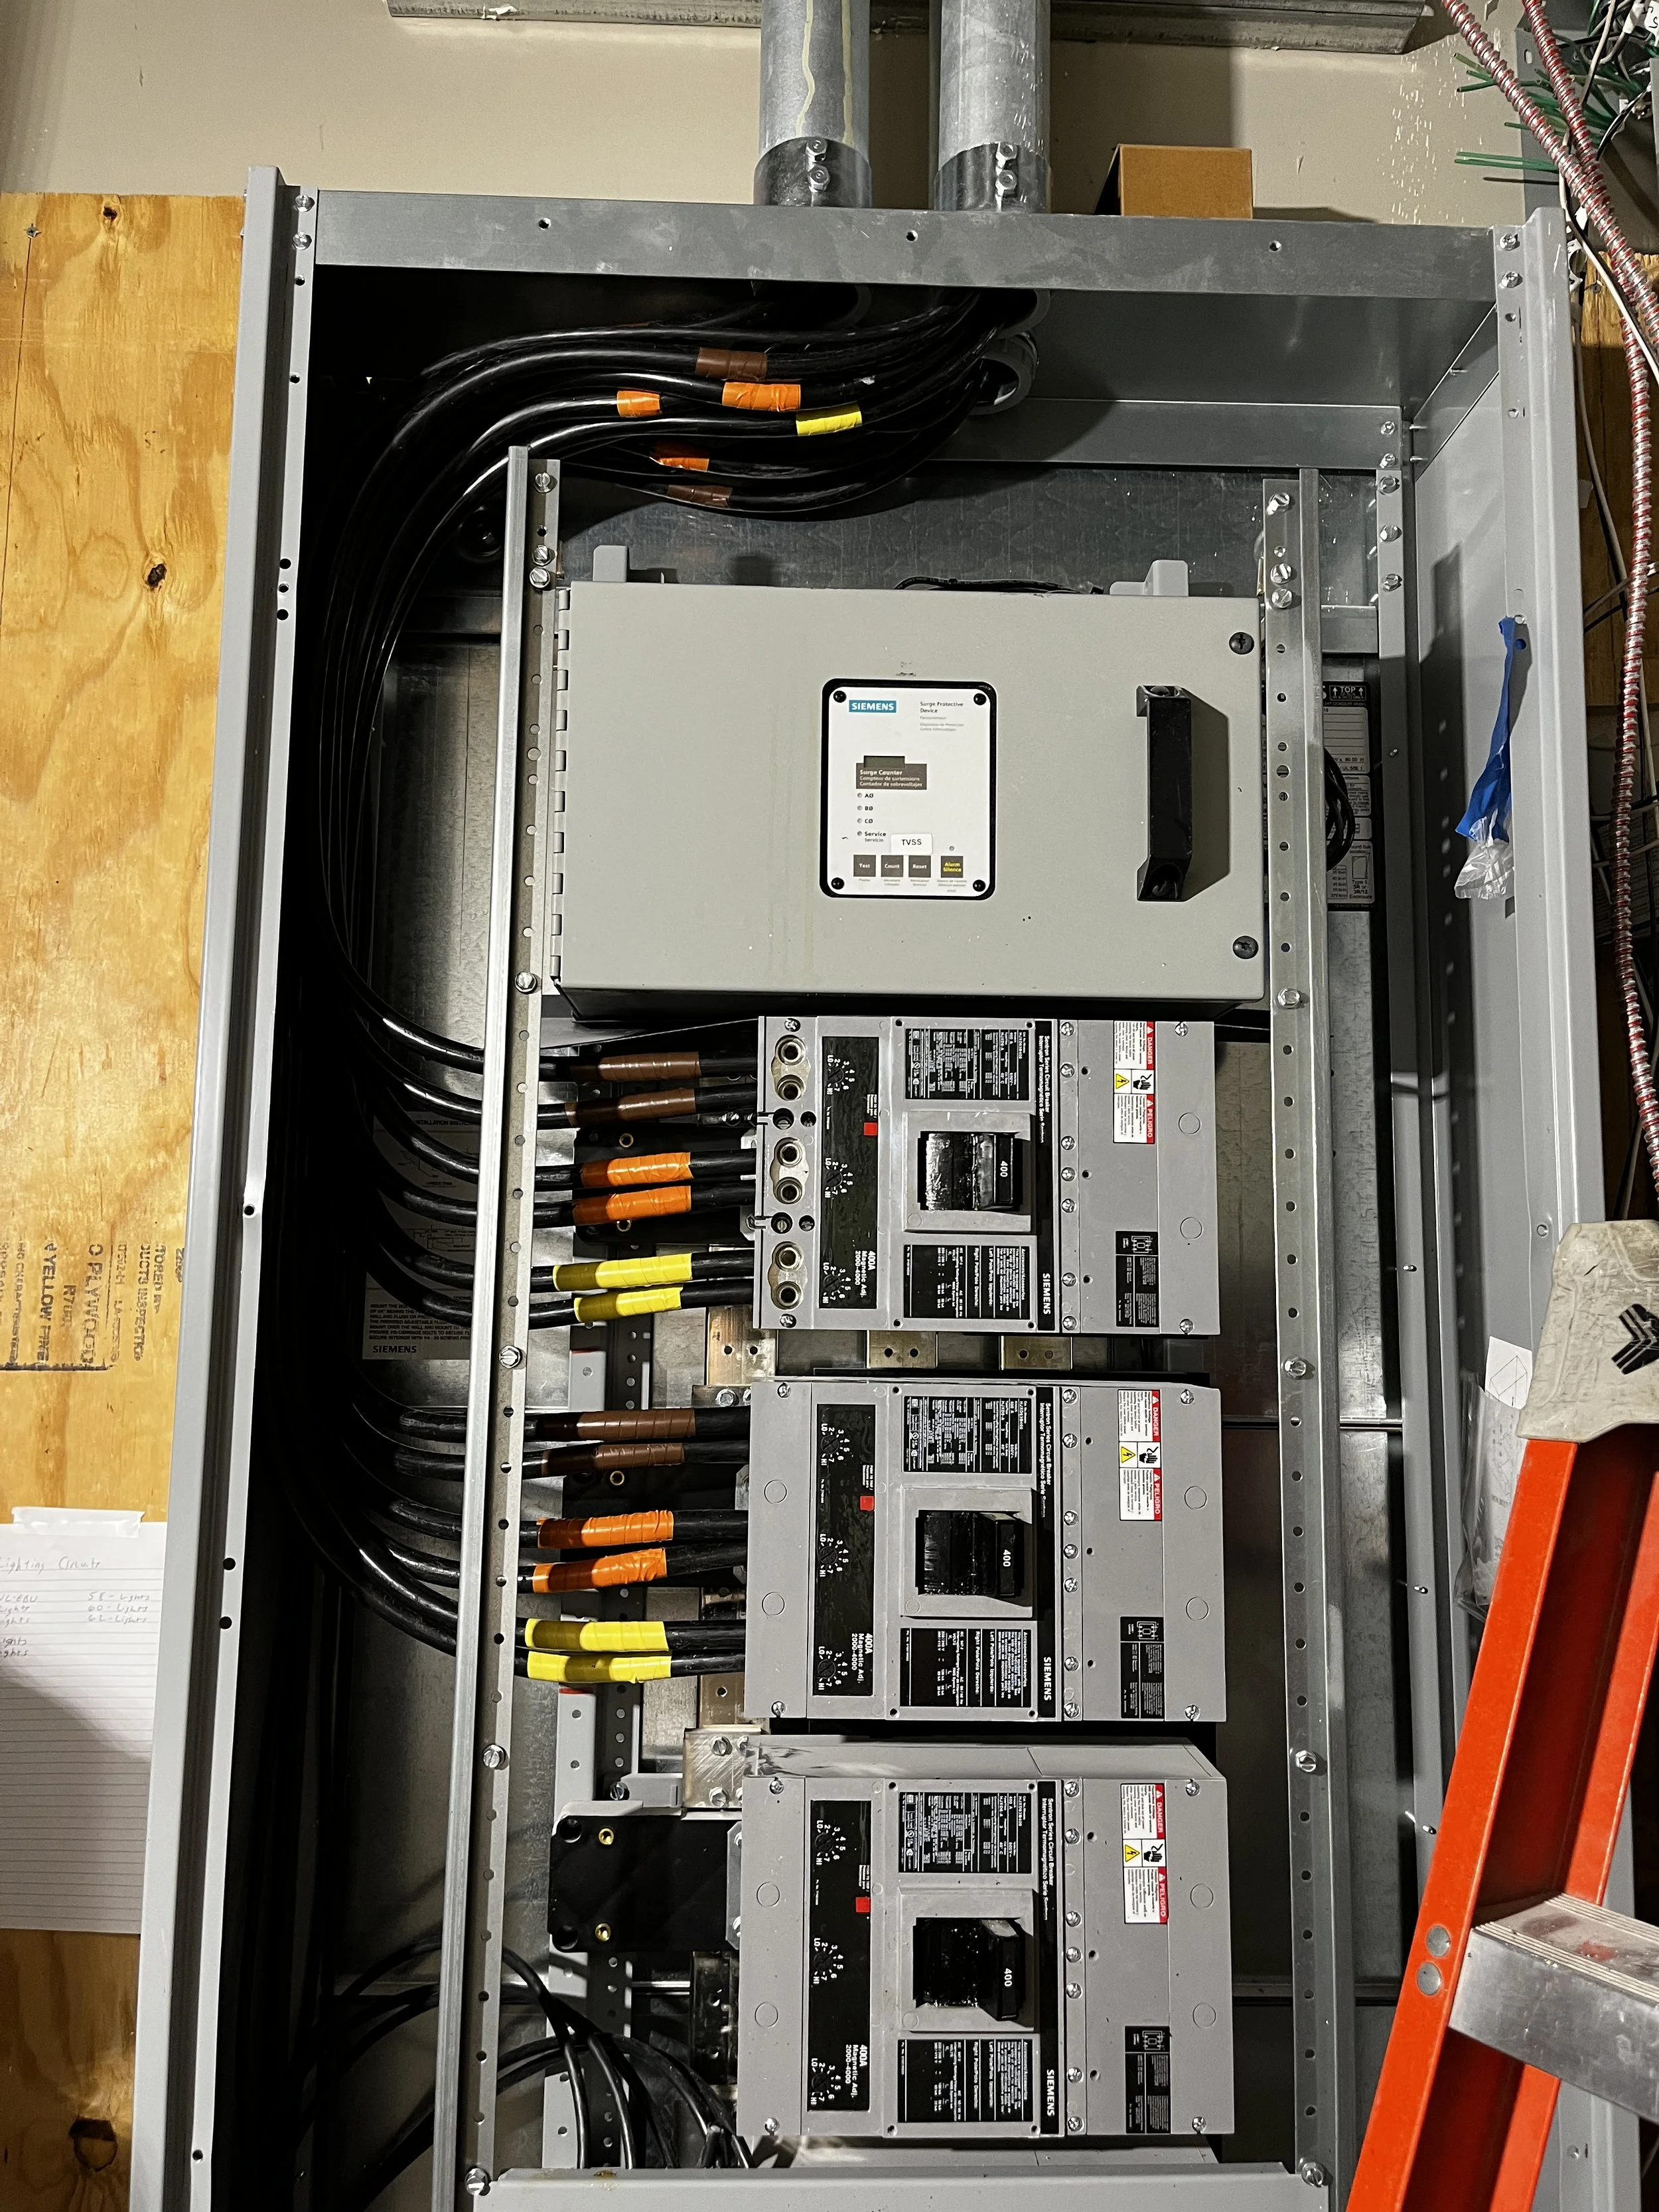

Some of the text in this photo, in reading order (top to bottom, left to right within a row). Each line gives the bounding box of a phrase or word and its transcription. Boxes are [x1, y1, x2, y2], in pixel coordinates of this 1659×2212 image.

[867, 1250, 876, 1270] 400A
[40, 1254, 56, 1321] YELLOW
[1043, 1273, 1051, 1314] SIEMENS
[821, 1423, 828, 1432] LO
[865, 1633, 873, 1654] 400A
[1043, 1657, 1052, 1701] SIEMENS
[817, 1820, 824, 1828] LO
[811, 2058, 818, 2067] LO
[859, 2044, 868, 2067] 400A
[1046, 2069, 1055, 2116] SIEMENS
